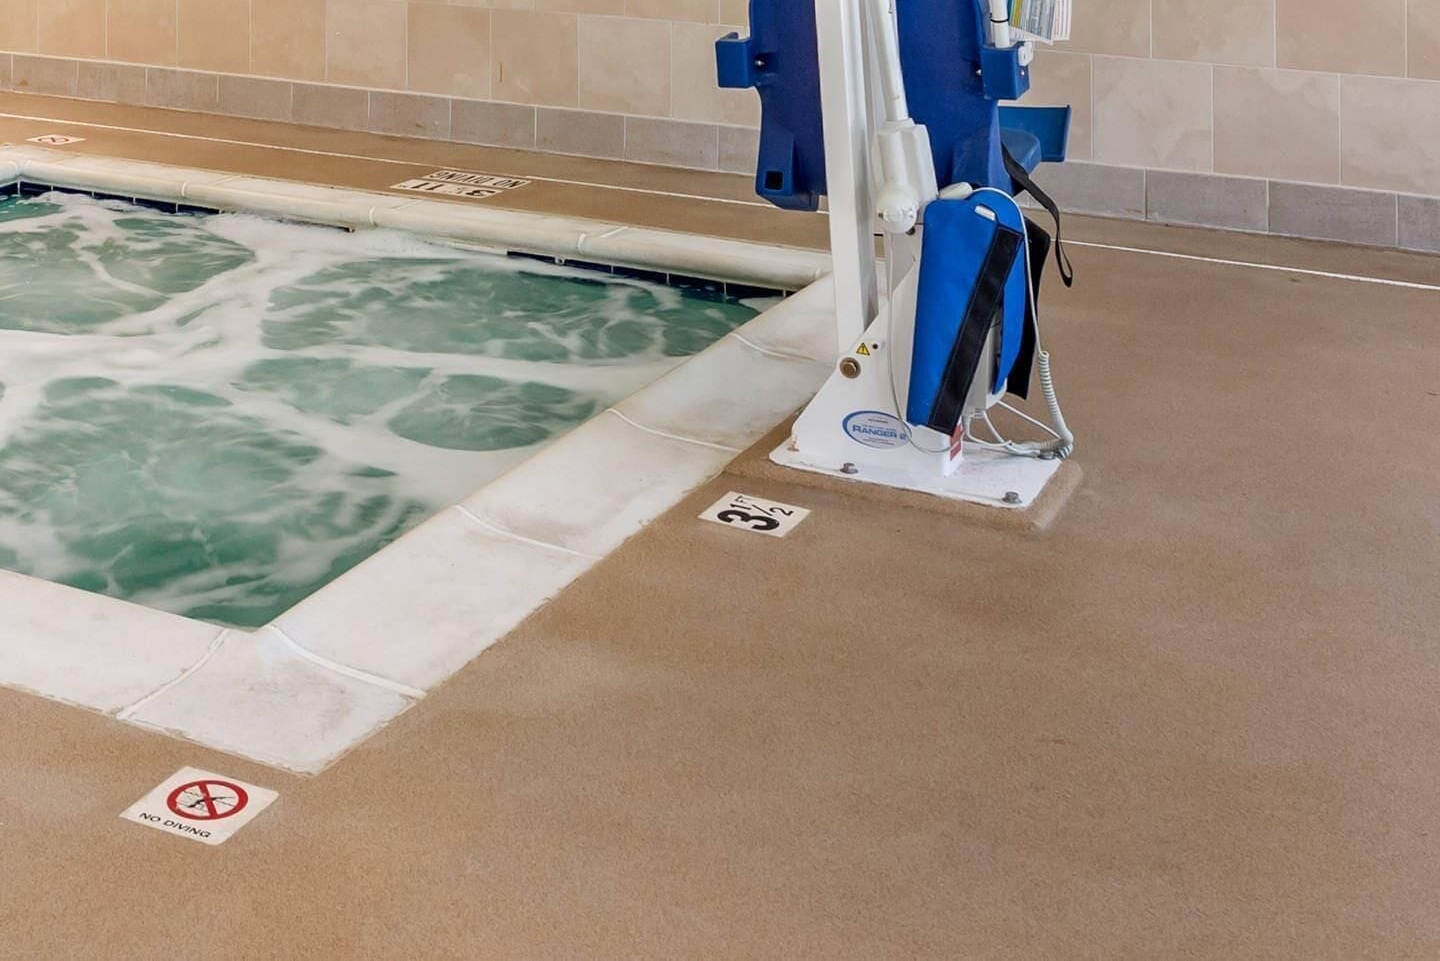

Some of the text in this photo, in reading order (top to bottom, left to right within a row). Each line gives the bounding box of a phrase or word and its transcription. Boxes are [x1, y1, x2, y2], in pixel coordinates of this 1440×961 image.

[852, 424, 897, 439] RANGER
[139, 812, 211, 839] NO DIVING
